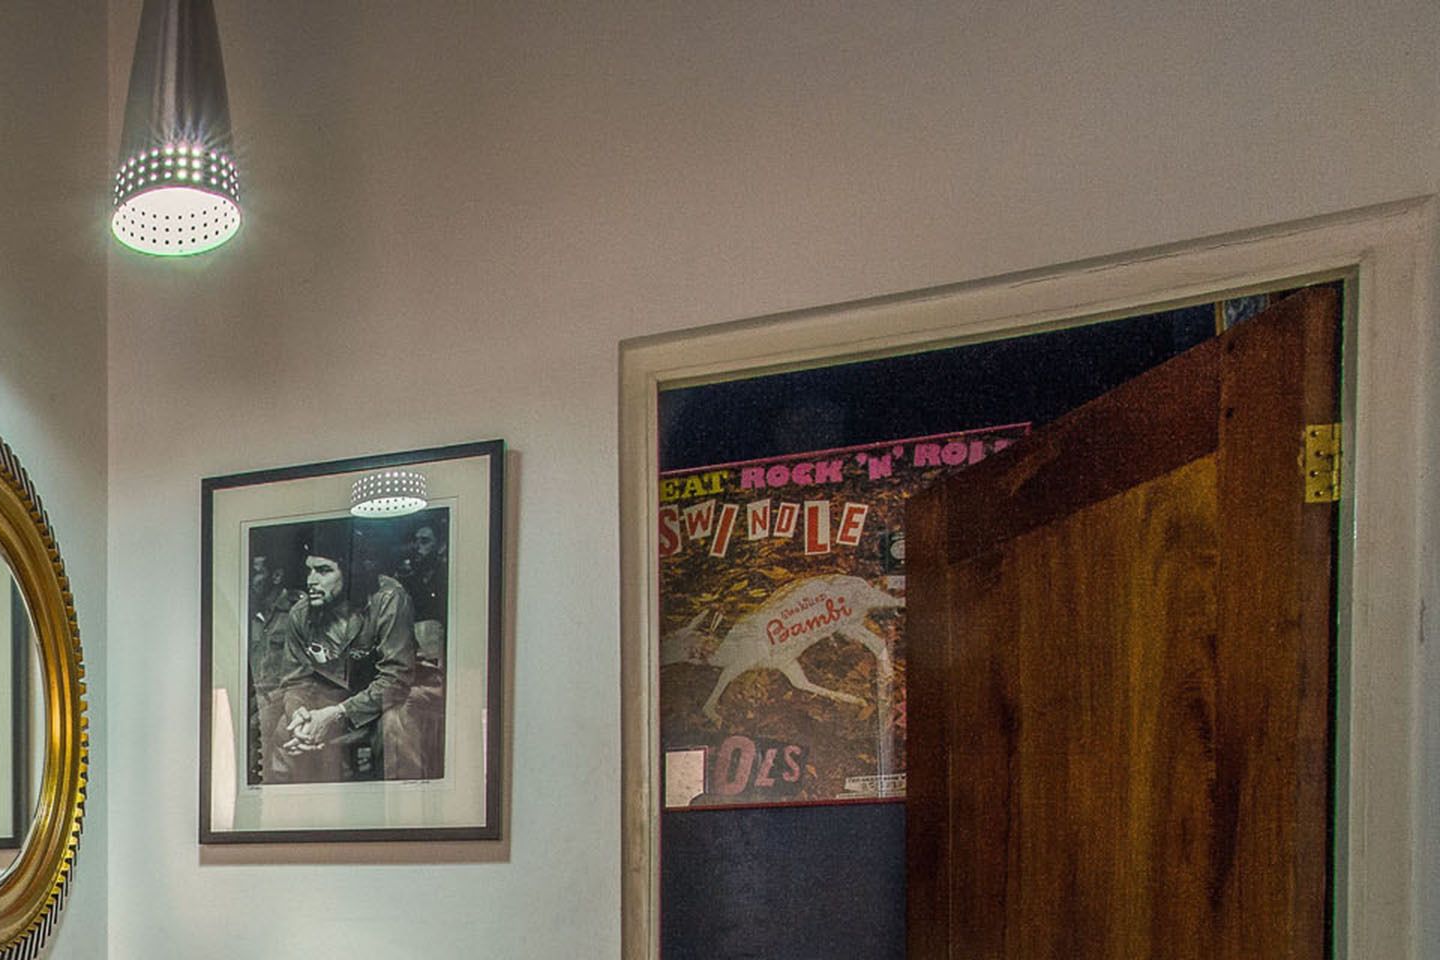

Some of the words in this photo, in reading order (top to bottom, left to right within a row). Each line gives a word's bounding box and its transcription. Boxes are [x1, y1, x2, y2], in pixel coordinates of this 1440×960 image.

[659, 470, 729, 502] EAT
[741, 459, 844, 489] ROCK
[913, 439, 1014, 467] ROL
[659, 499, 867, 556] SWINDLE
[766, 596, 853, 645] Bambi
